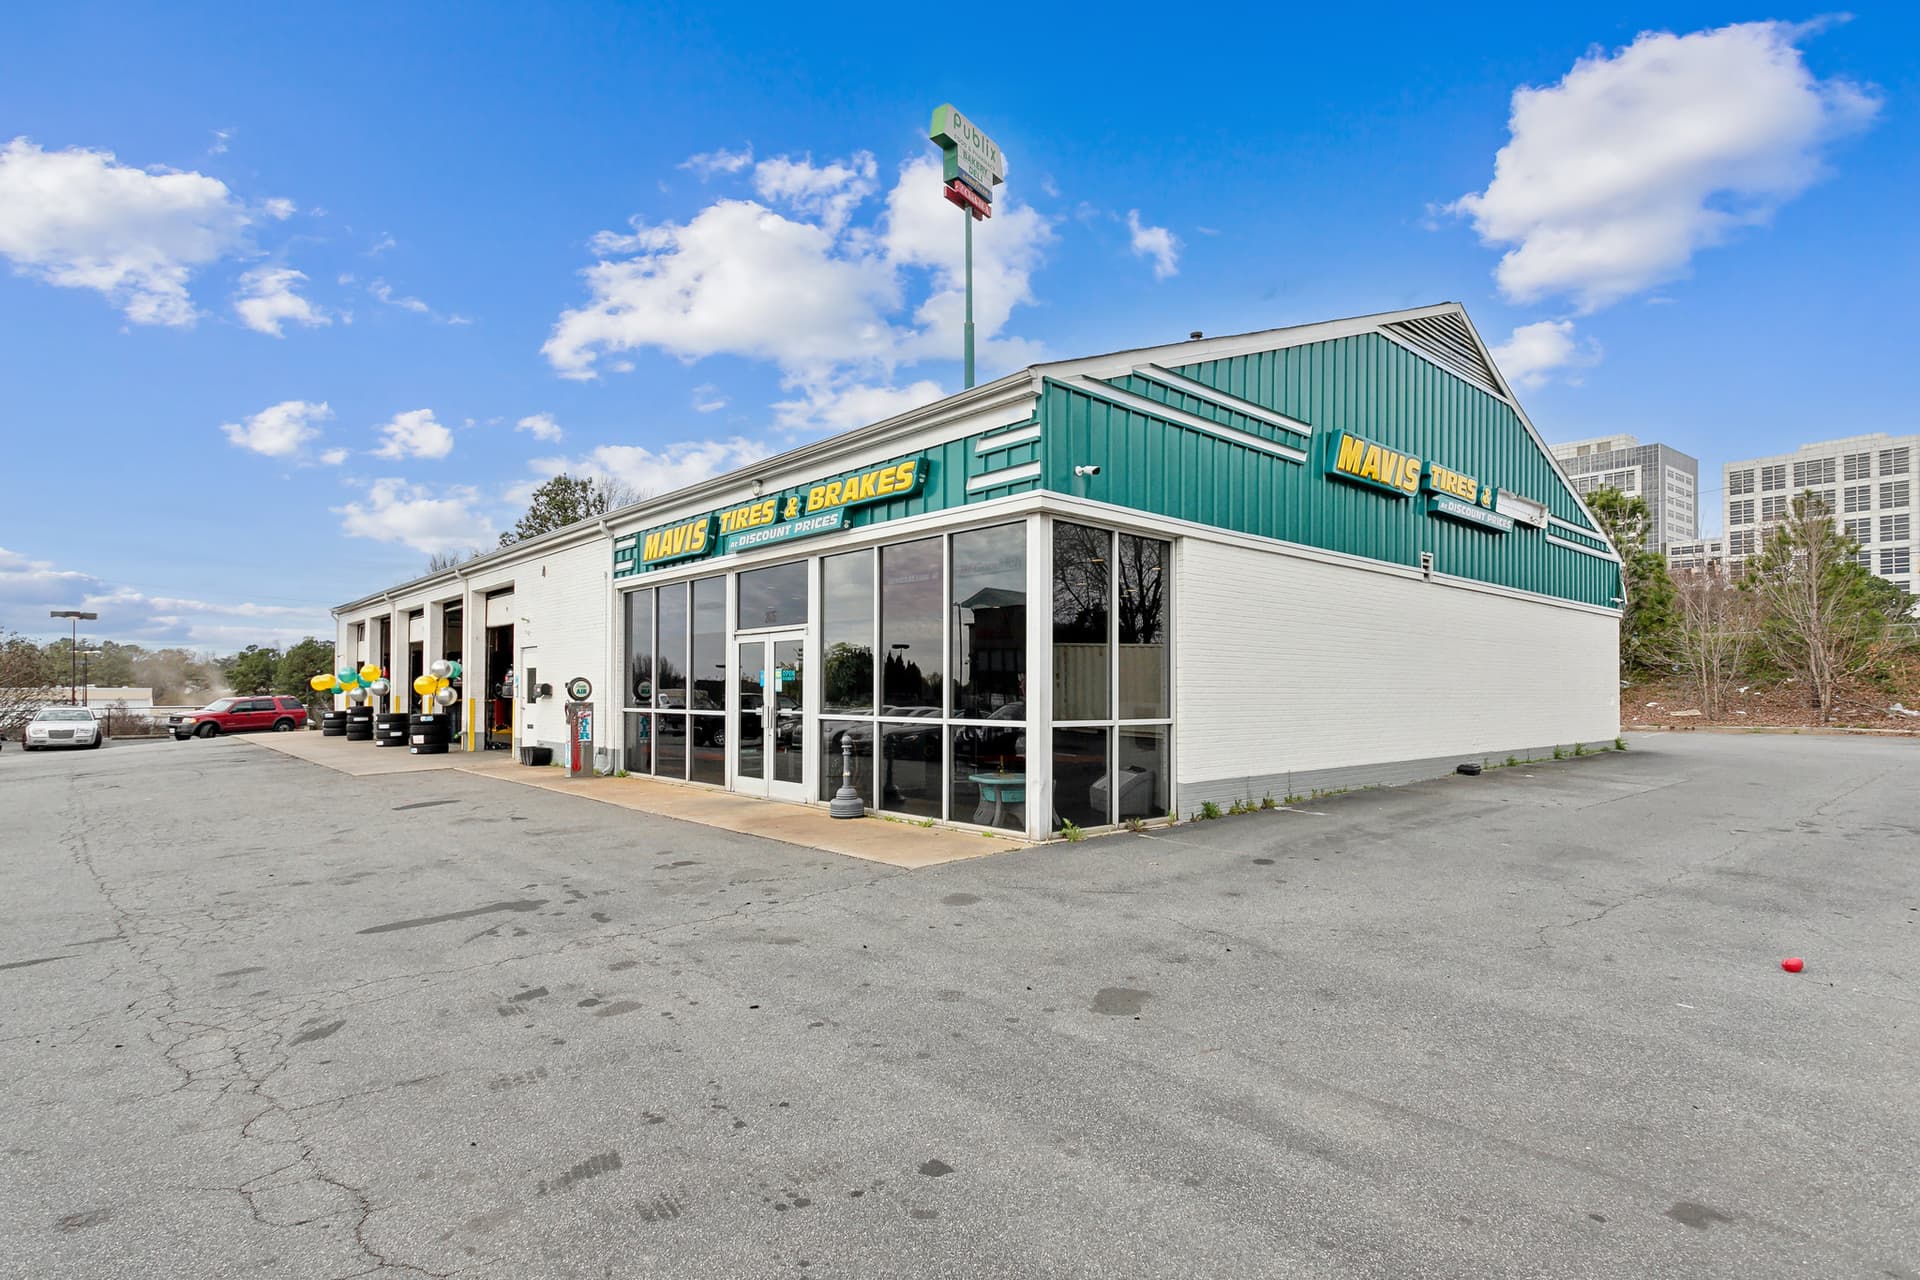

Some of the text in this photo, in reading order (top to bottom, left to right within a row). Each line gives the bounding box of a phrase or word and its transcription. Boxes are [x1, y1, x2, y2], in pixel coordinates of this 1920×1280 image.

[1337, 434, 1492, 506] MAVIS TIRES &
[643, 460, 916, 562] MAVIS TIRES & BRAKES
[1448, 502, 1486, 521] DISCOUNT
[1487, 513, 1512, 530] PRICES
[739, 526, 792, 546] DISCOUNT
[795, 513, 838, 533] PRICES
[579, 718, 590, 739] AIR
